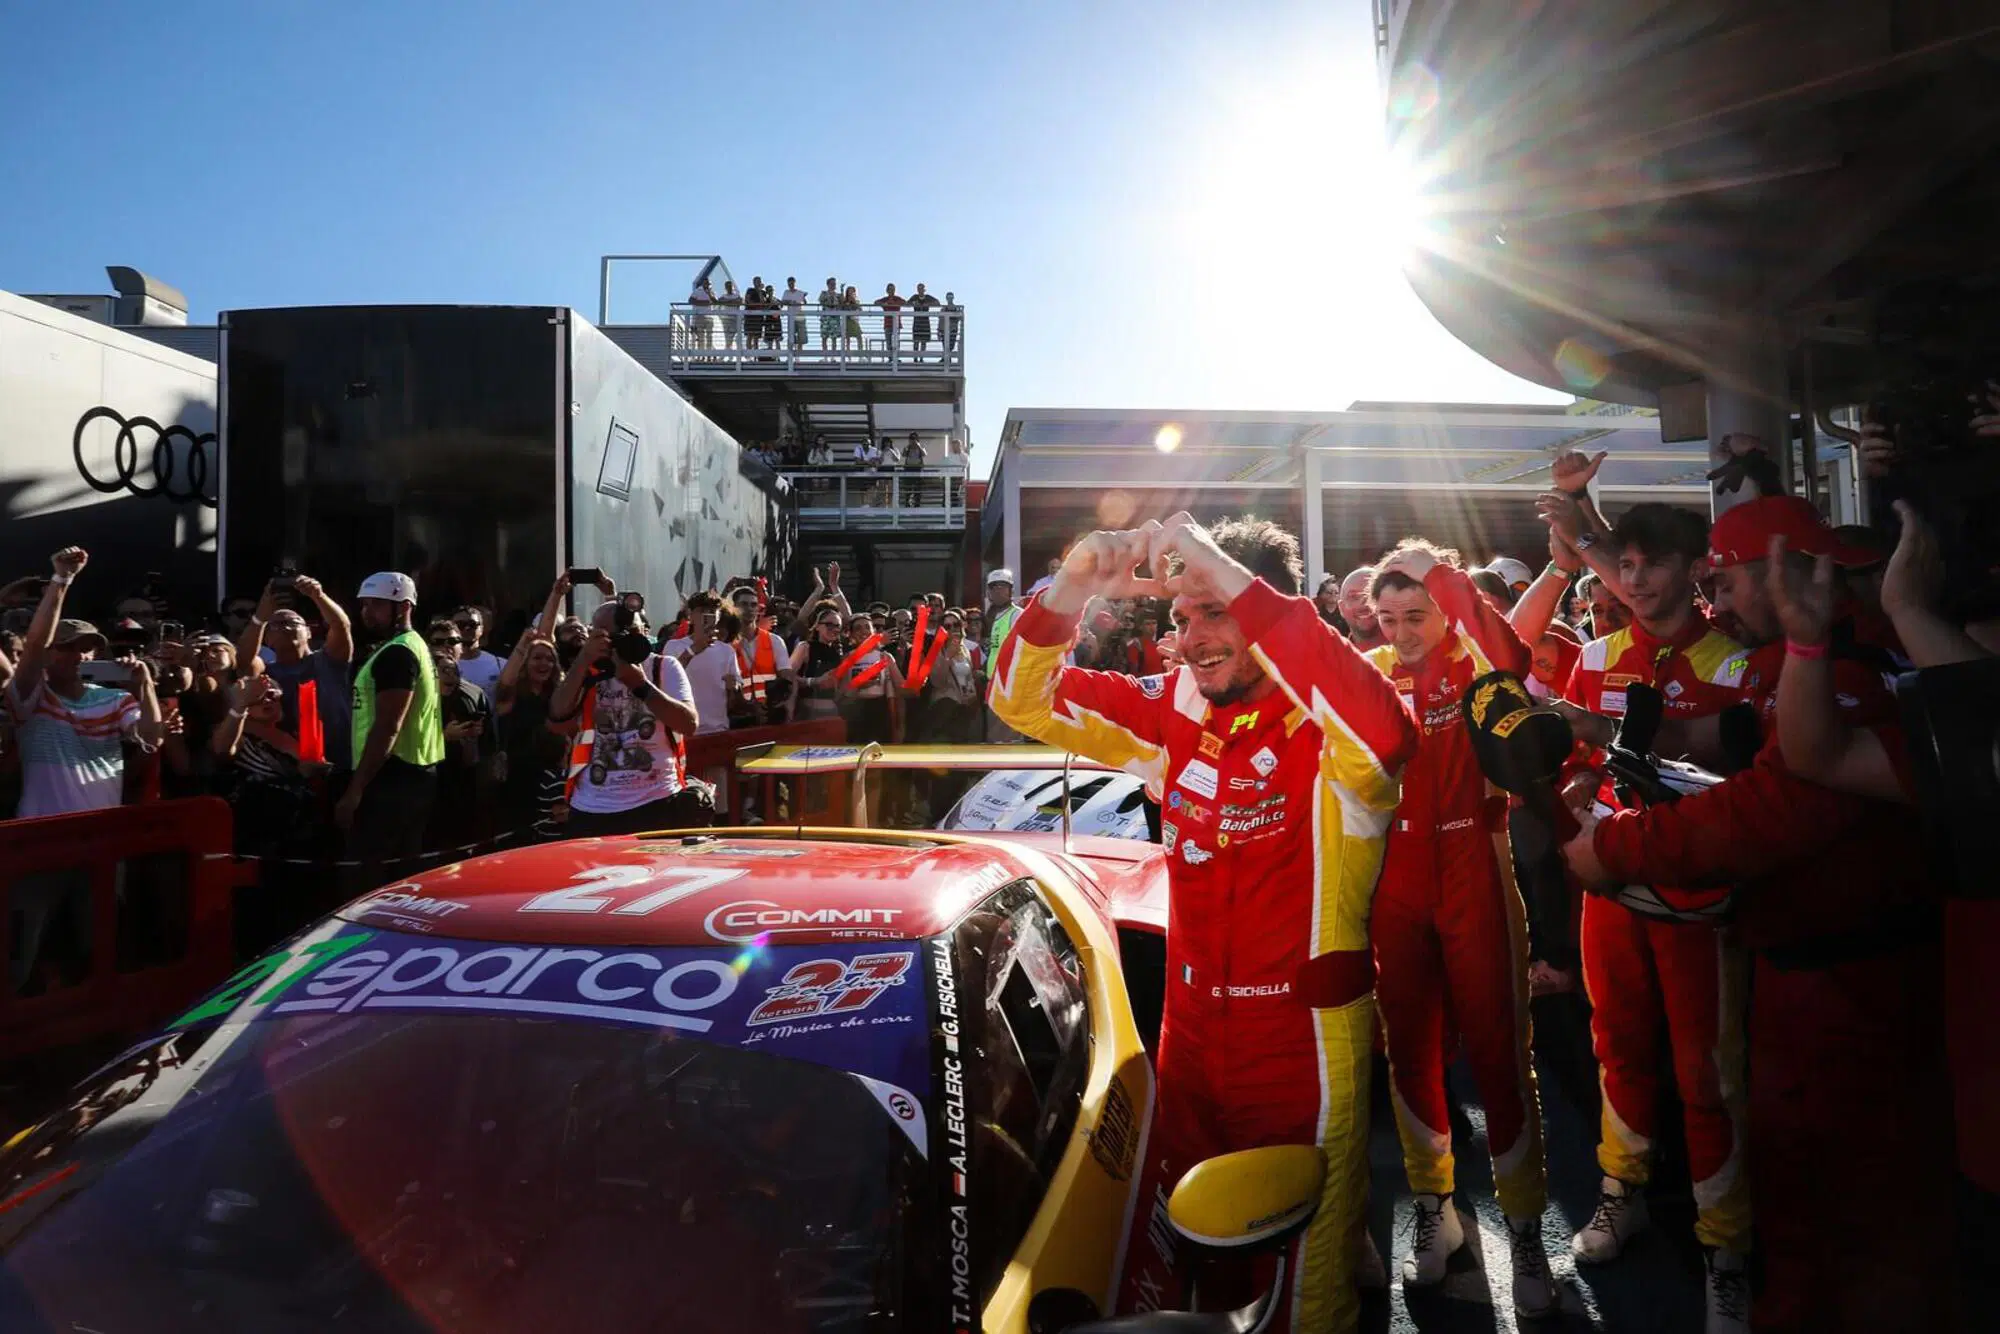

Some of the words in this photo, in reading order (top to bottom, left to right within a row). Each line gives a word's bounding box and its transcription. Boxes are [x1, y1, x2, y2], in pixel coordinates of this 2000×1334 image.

[1441, 818, 1474, 831] MOSCA
[516, 865, 751, 916] 27
[724, 908, 903, 926] COMMIT
[831, 930, 904, 939] METALLI
[305, 946, 739, 1014] sparco
[746, 951, 914, 1027] 27
[757, 1003, 815, 1019] Network
[740, 1030, 766, 1045] La
[768, 1023, 834, 1039] Musica
[840, 1014, 865, 1028] che
[871, 1014, 913, 1024] corre
[943, 1056, 967, 1149] LECLERC
[949, 1150, 968, 1174] A.
[950, 1205, 970, 1300] MOSCA
[952, 1303, 971, 1324] T.
